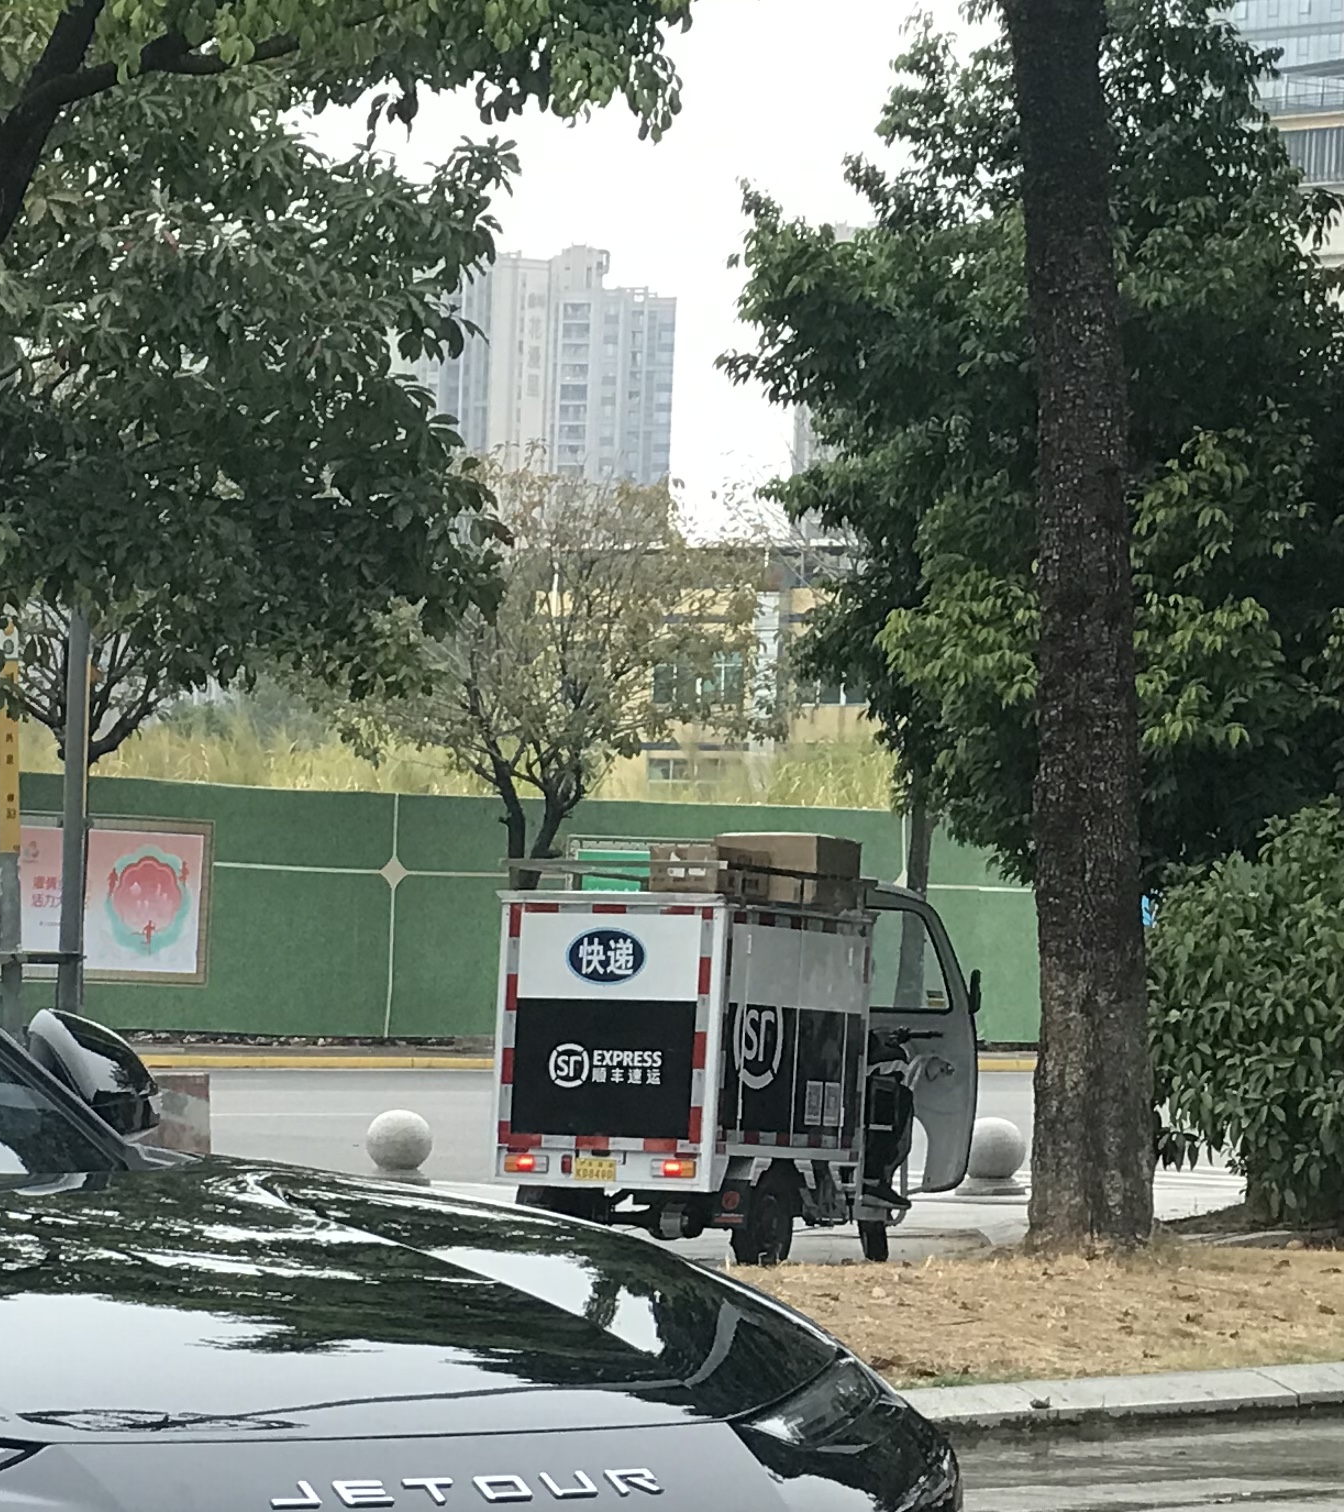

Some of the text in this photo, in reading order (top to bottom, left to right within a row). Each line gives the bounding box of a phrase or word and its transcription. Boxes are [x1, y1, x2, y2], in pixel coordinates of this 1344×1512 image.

[578, 937, 634, 975] 快递
[593, 1050, 662, 1067] EXPRESS
[591, 1068, 661, 1085] 顺丰速运
[269, 1467, 665, 1510] JETOUR
